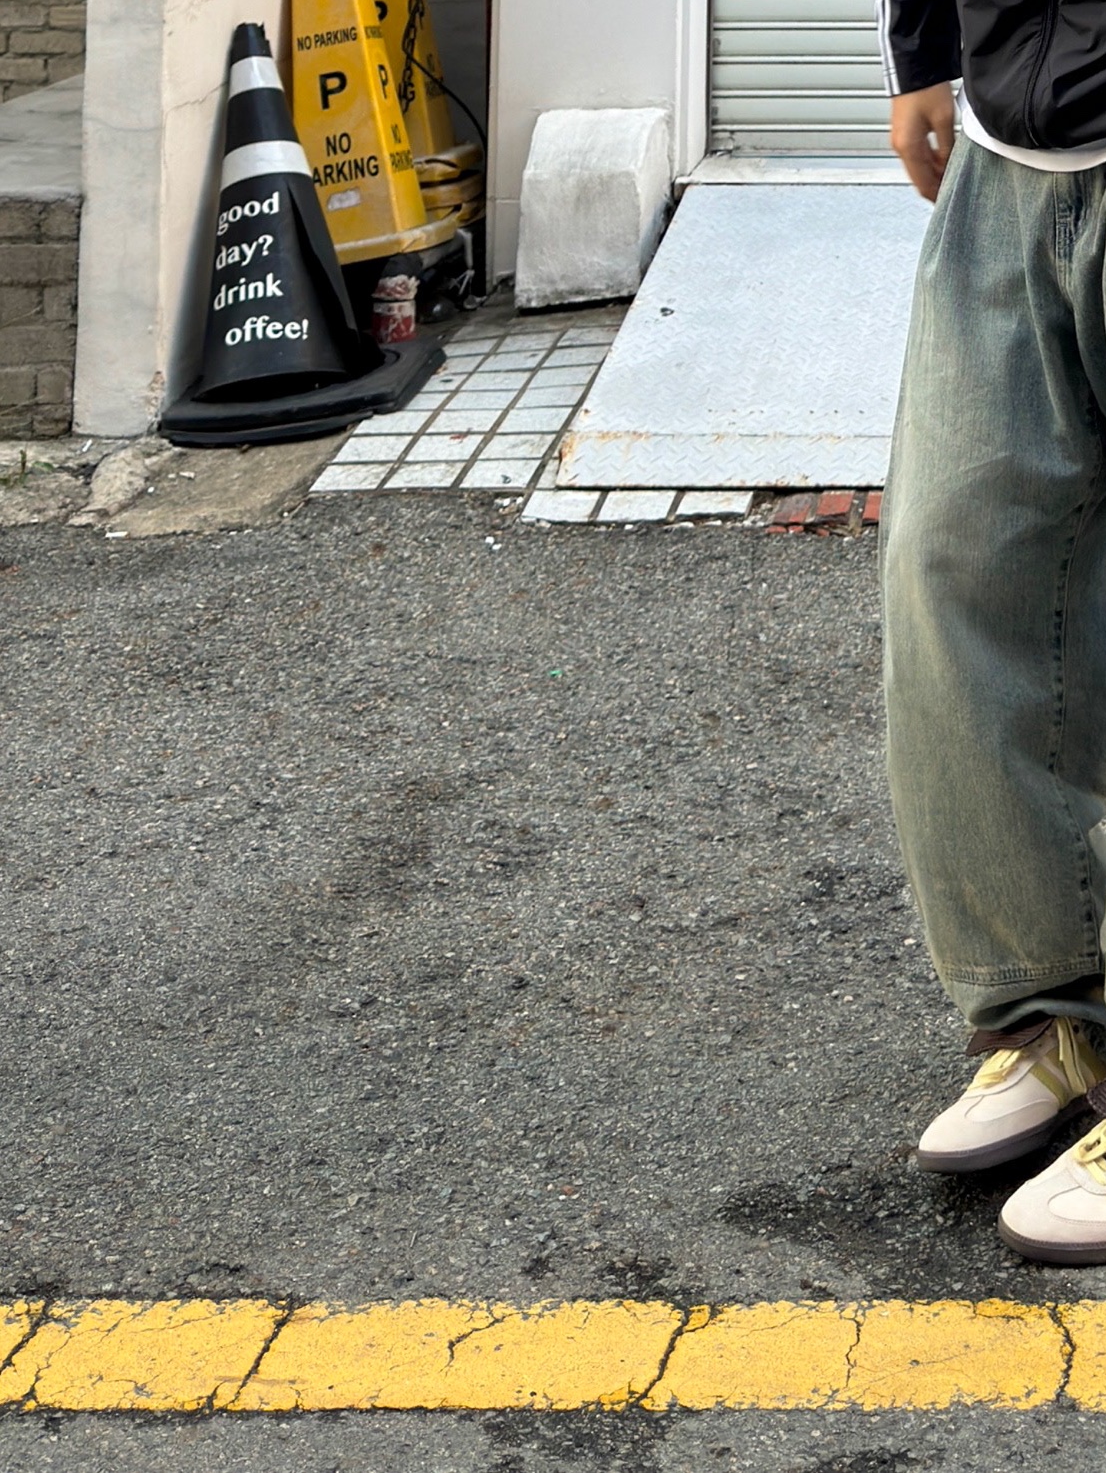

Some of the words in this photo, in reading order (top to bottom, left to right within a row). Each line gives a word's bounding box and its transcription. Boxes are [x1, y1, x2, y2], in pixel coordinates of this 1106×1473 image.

[296, 37, 312, 52] NO
[313, 27, 358, 50] PARKING
[318, 70, 348, 111] P
[325, 131, 352, 158] NO
[313, 154, 380, 188] ARKING
[216, 190, 280, 237] good
[215, 234, 274, 271] day?
[213, 272, 285, 312] drink
[224, 315, 309, 347] offee!
